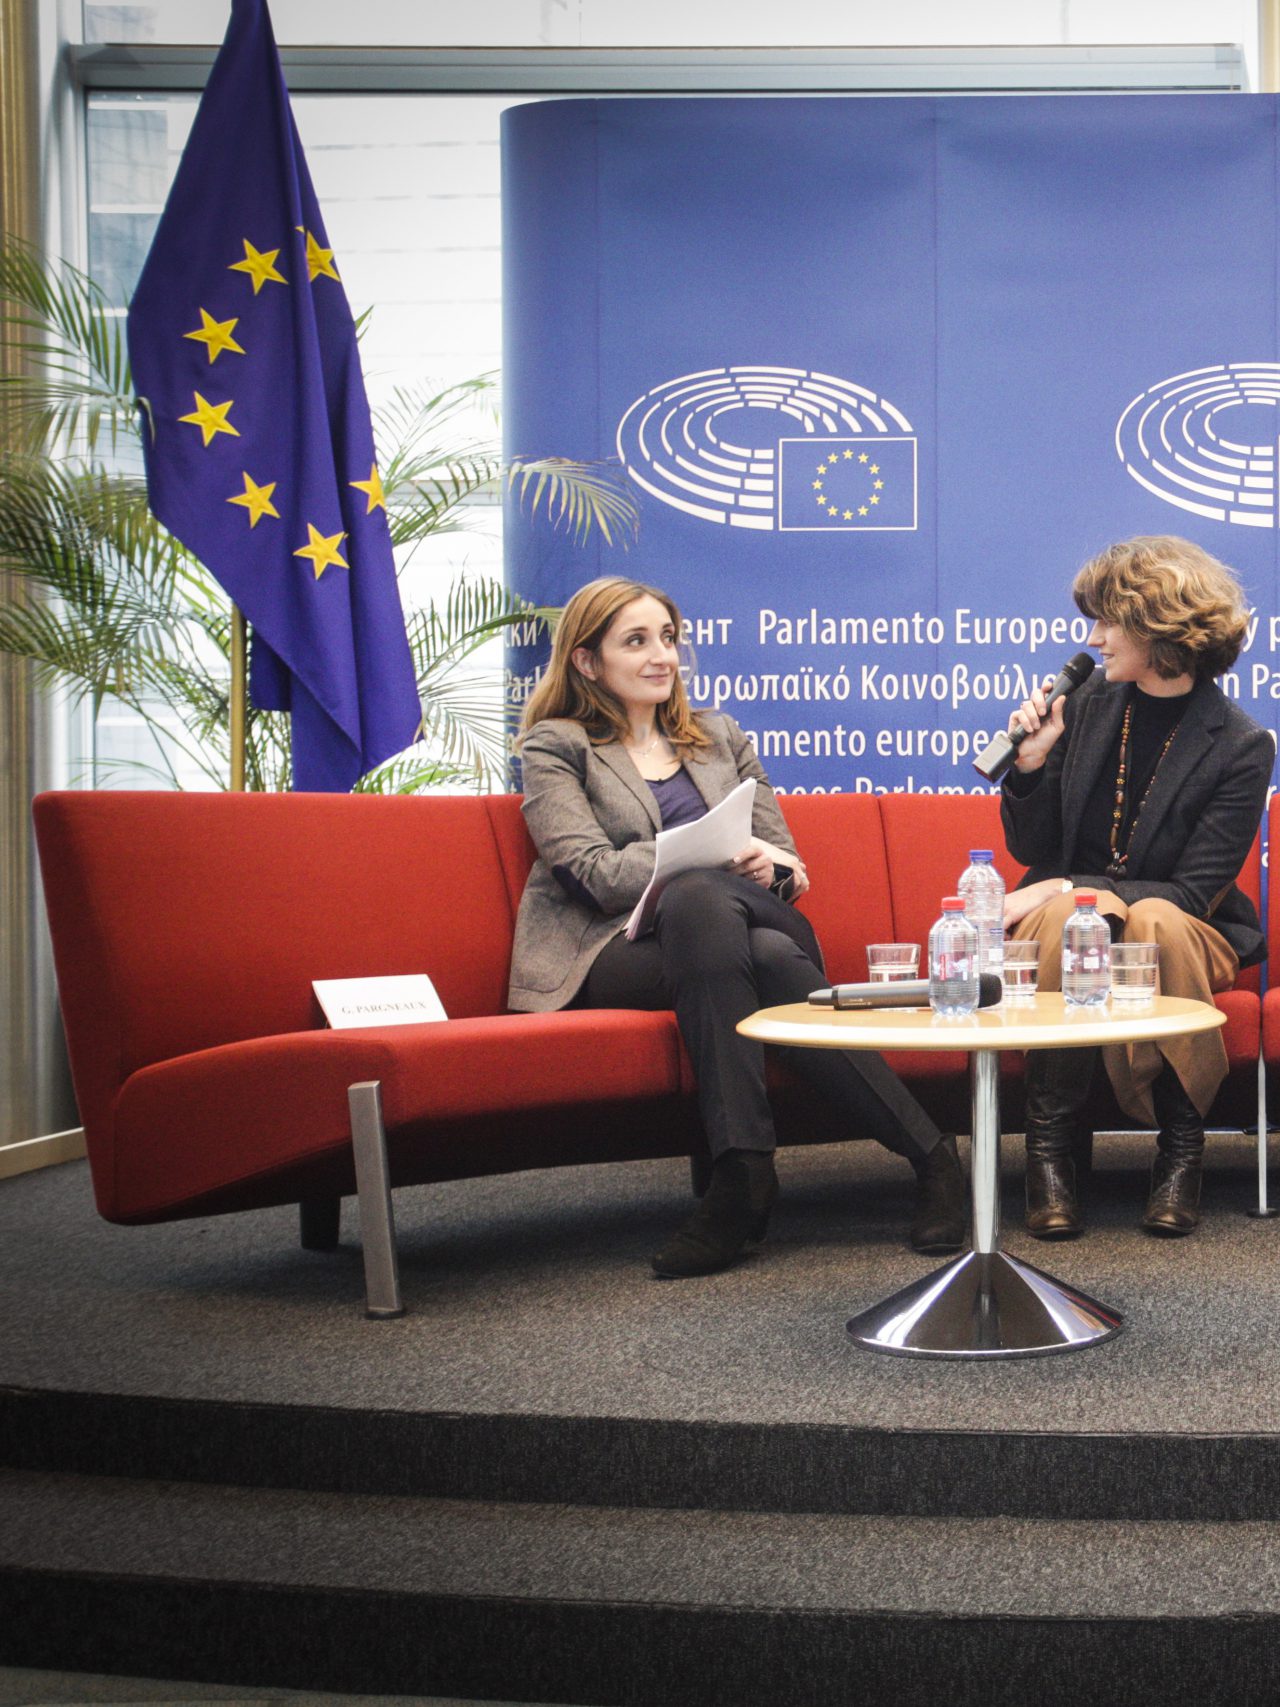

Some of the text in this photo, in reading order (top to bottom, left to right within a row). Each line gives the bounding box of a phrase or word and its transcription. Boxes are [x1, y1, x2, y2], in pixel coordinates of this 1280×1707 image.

[759, 608, 944, 645] Parlamento
[955, 608, 1088, 653] Europeo
[745, 724, 866, 757] amento
